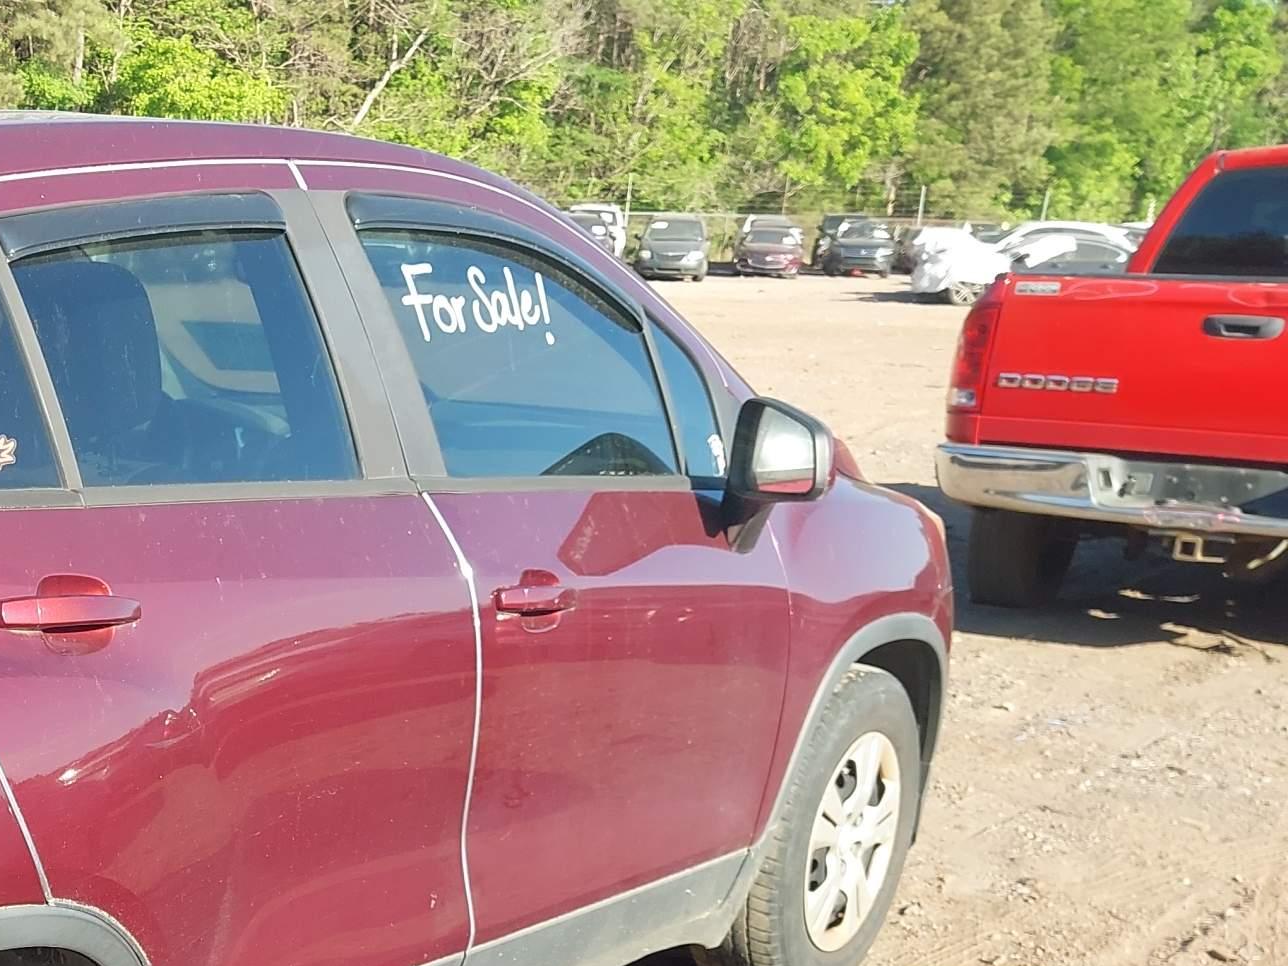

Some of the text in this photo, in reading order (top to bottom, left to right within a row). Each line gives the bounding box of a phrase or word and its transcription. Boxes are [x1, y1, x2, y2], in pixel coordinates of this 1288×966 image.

[400, 262, 556, 345] For Sale!
[998, 372, 1119, 393] DODGE
